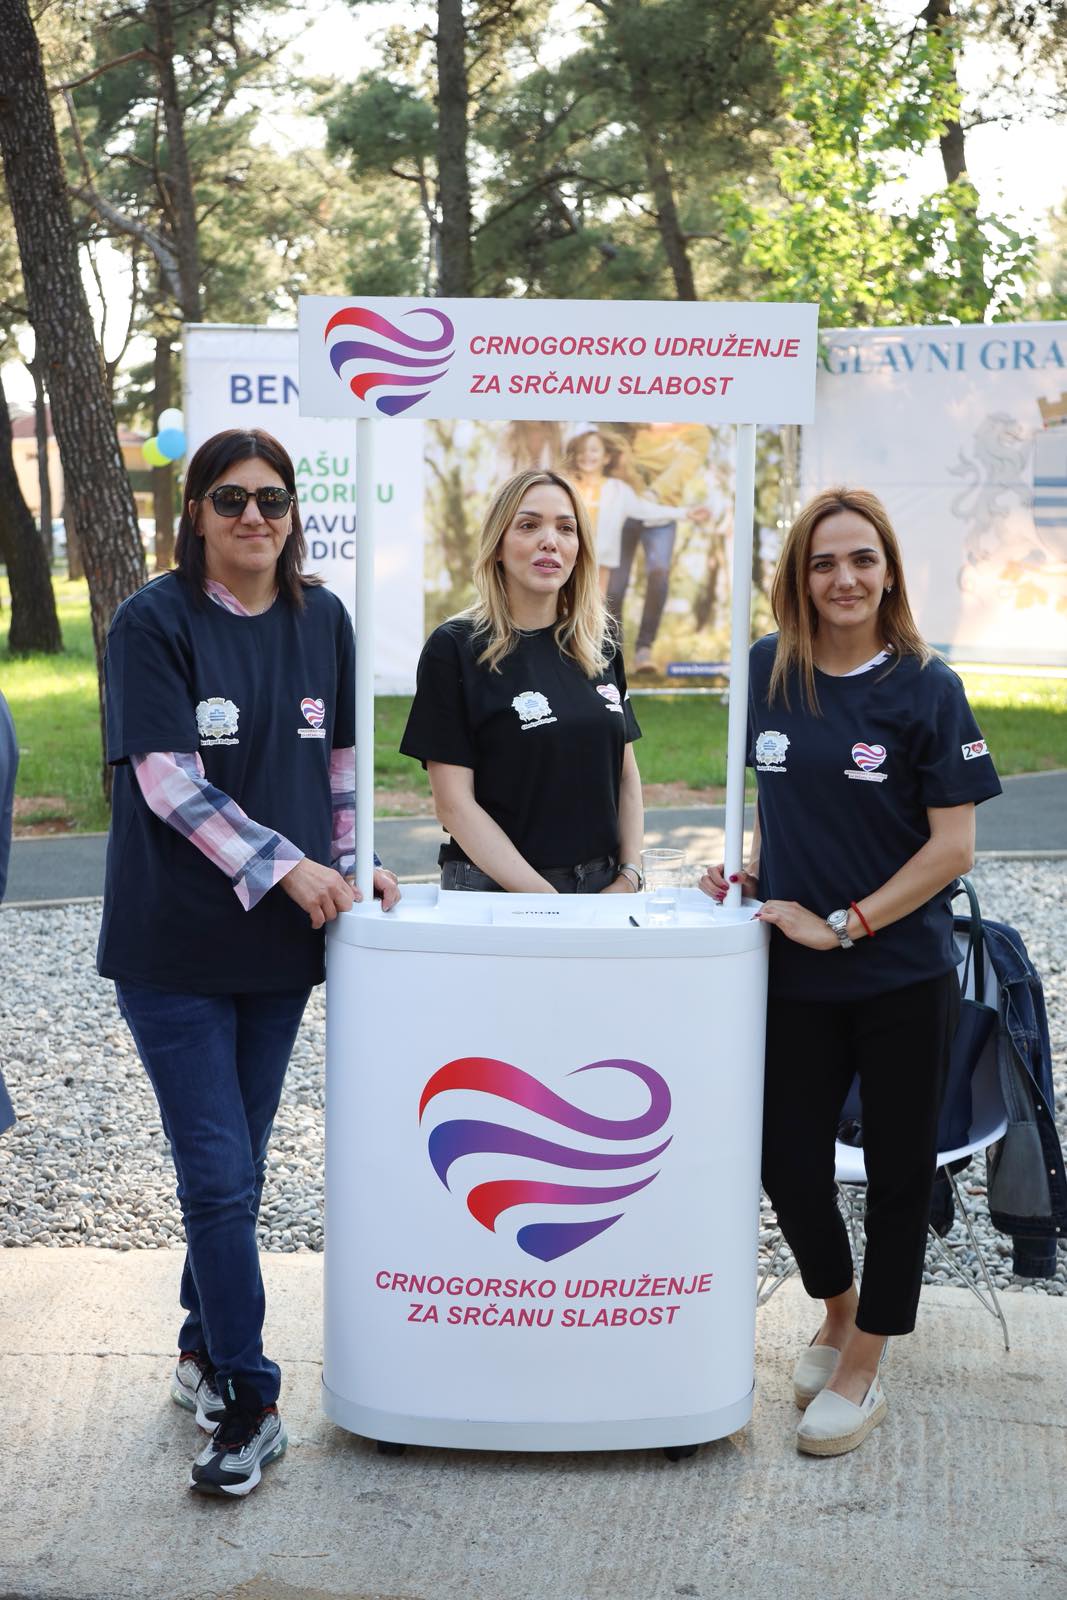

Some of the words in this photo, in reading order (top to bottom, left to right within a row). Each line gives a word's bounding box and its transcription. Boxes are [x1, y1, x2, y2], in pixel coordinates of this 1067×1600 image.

[469, 336, 647, 357] CRNOGORSKO
[654, 333, 800, 358] UDRUŽENJE
[822, 341, 967, 376] GLAVNI
[470, 375, 501, 394] ZA
[508, 371, 611, 394] SRČANU
[618, 376, 734, 396] SLABOST
[375, 1270, 556, 1298] CRNOGORSKO
[564, 1272, 714, 1298] UDRUŽENJE
[407, 1303, 439, 1323] ZA
[447, 1303, 553, 1328] SRČANU
[561, 1305, 681, 1327] SLABOST
